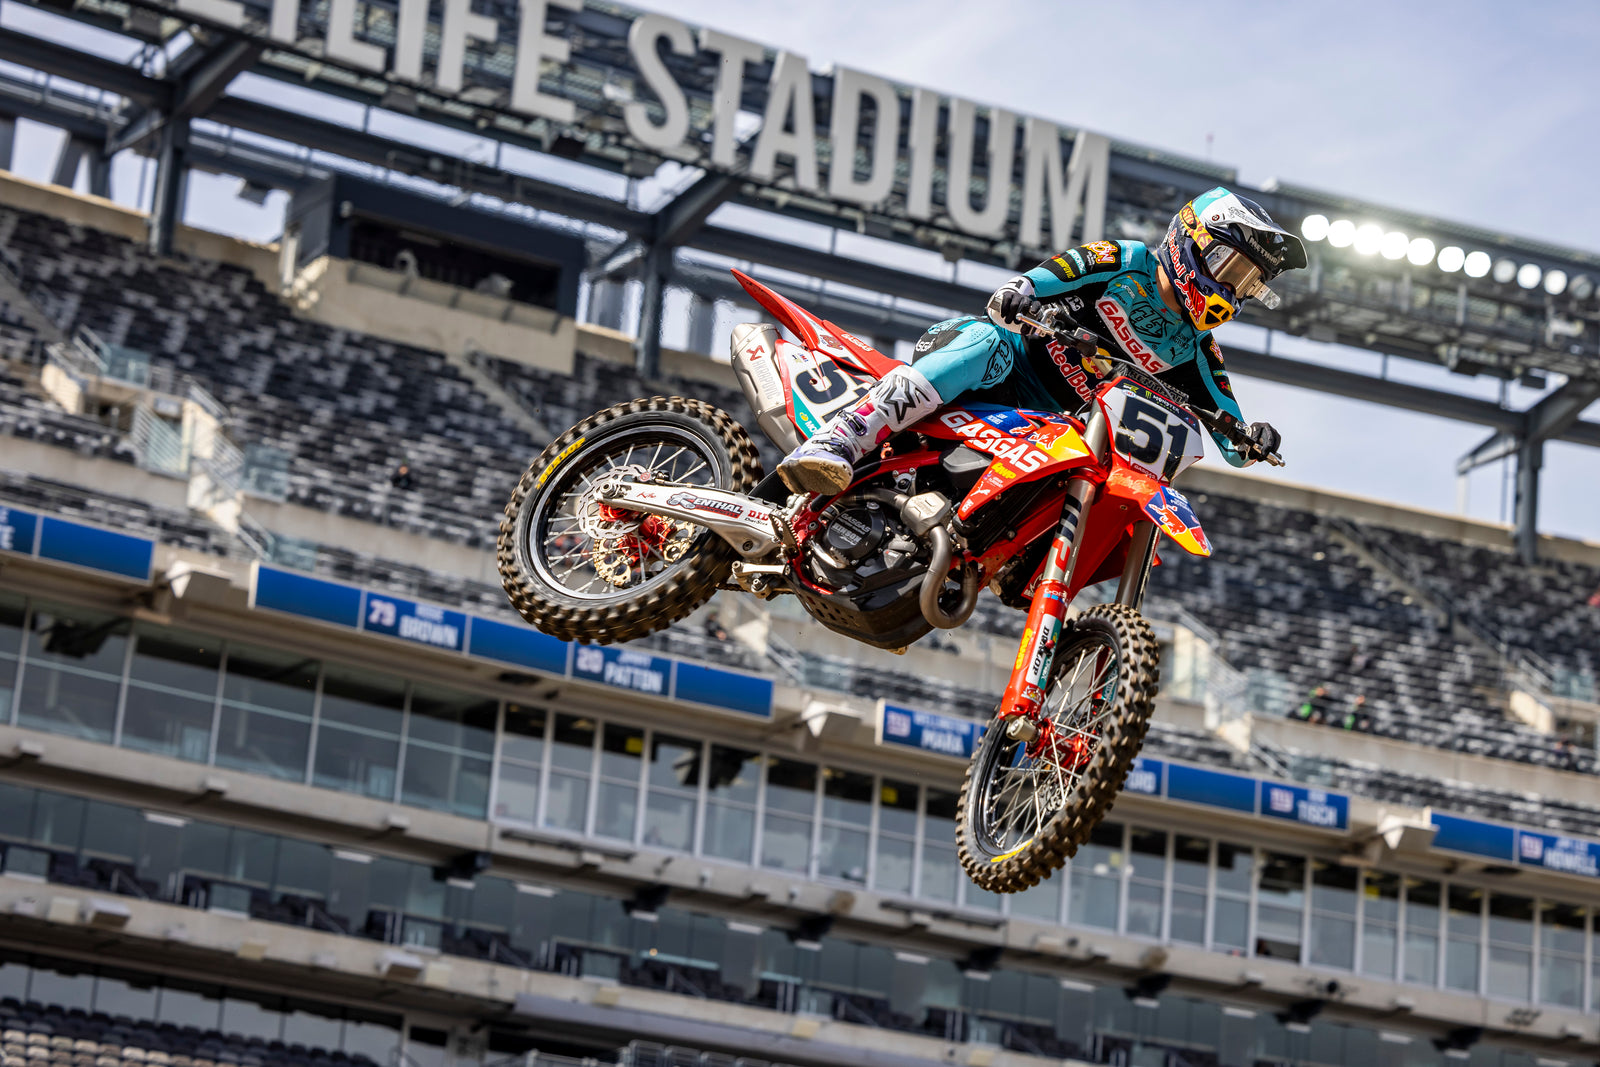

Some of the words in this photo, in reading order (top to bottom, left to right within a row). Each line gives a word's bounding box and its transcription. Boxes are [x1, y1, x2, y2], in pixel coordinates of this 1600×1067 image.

[178, 0, 583, 123] LIFE
[624, 14, 1110, 250] STADIUM
[1170, 248, 1187, 277] Bull
[1098, 301, 1163, 374] GASGAS
[1044, 338, 1082, 378] Red
[940, 410, 1049, 473] GASGAS
[1114, 395, 1188, 481] 51
[840, 511, 871, 532] GASGAS
[400, 615, 459, 649] BROWN
[604, 661, 663, 693] PATTON
[921, 729, 965, 755] MARA
[1297, 800, 1338, 827] TISCH
